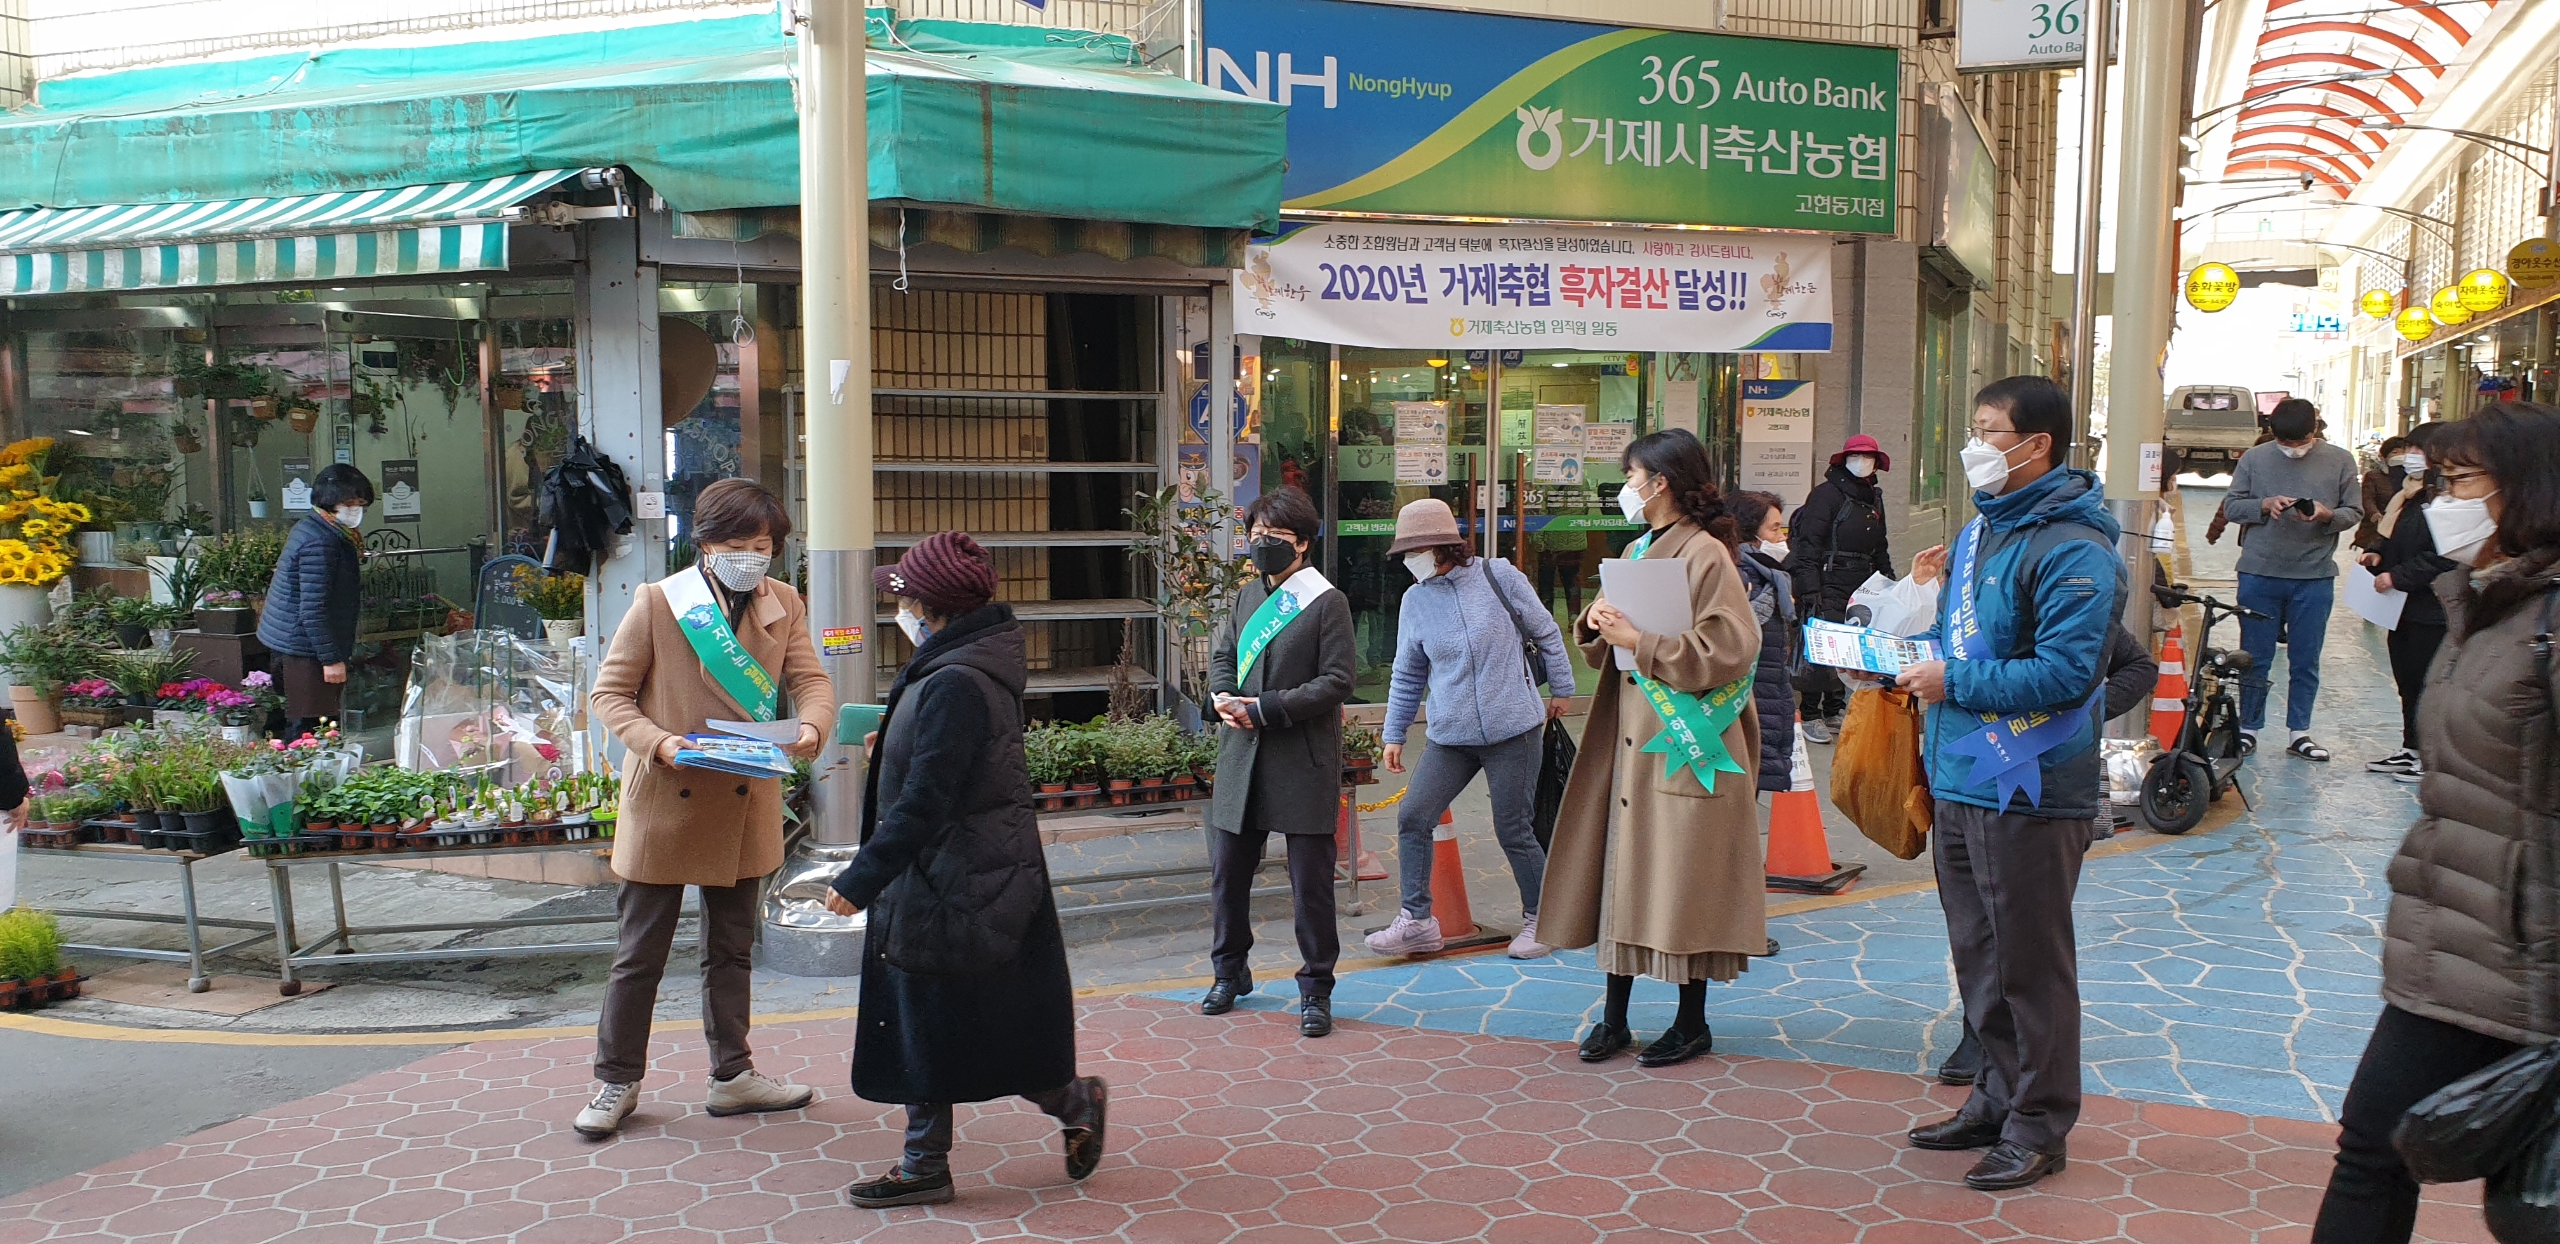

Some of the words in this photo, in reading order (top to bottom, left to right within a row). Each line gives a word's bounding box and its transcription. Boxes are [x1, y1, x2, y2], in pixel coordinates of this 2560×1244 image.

[2028, 0, 2085, 39] 36
[2028, 43, 2062, 55] Auto
[2065, 41, 2083, 53] Ba
[1207, 47, 1338, 108] NH
[1349, 72, 1453, 101] NongHyup
[1638, 55, 1721, 110] 365
[1732, 71, 1808, 105] Auto
[1813, 77, 1887, 112] Bank
[1569, 117, 1887, 181] 거제시축산농협
[1795, 194, 1885, 218] 고현동지점
[1324, 234, 1359, 250] 소중한
[1362, 235, 1420, 251] 조합원님과
[1422, 237, 1456, 252] 고객님
[1459, 238, 1493, 252] 덕분에
[1556, 237, 1635, 254] 달성하였습니다.
[1643, 241, 1684, 256] 사랑하고
[1689, 243, 1754, 260] 감사드립니다.
[1318, 263, 1428, 304] 2020년
[1439, 262, 1551, 307] 거제축협
[1559, 264, 1670, 310] 흑자결산
[1675, 269, 1748, 311] 달성!!
[2188, 281, 2238, 293] 송화꽃방
[1467, 319, 1547, 335] 거제축산농협
[1551, 319, 1587, 335] 임직원
[1591, 321, 1618, 337] 일동
[1470, 351, 1486, 360] ADT
[1503, 351, 1520, 360] ADT
[1747, 386, 1769, 395] NH
[1757, 407, 1810, 418] 거제축산농협
[1370, 523, 1397, 532] 반갑습
[711, 624, 749, 668] 지구는
[1250, 616, 1283, 652] 지구는
[1669, 716, 1705, 761] 하세요
